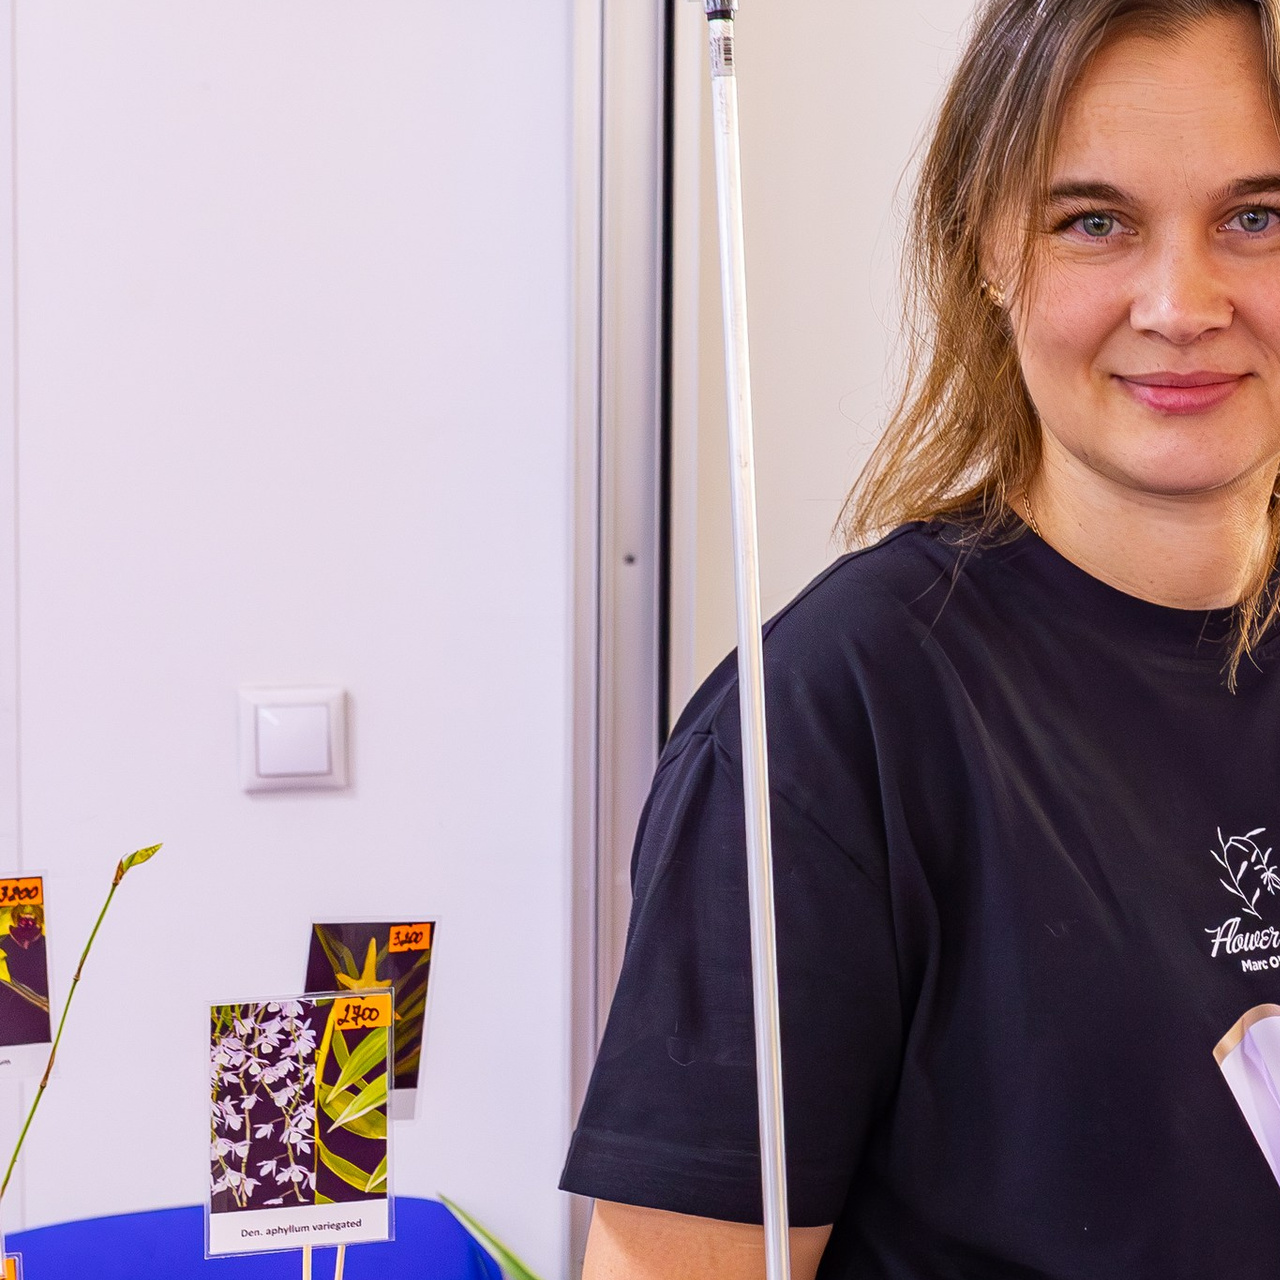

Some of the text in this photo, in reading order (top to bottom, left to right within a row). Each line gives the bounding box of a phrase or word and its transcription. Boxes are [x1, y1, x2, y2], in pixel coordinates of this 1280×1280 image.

[1204, 917, 1280, 958] Flower
[1241, 959, 1268, 972] Marc
[337, 1004, 380, 1026] 2700
[241, 1218, 362, 1237] Den. aphyllum variegated
